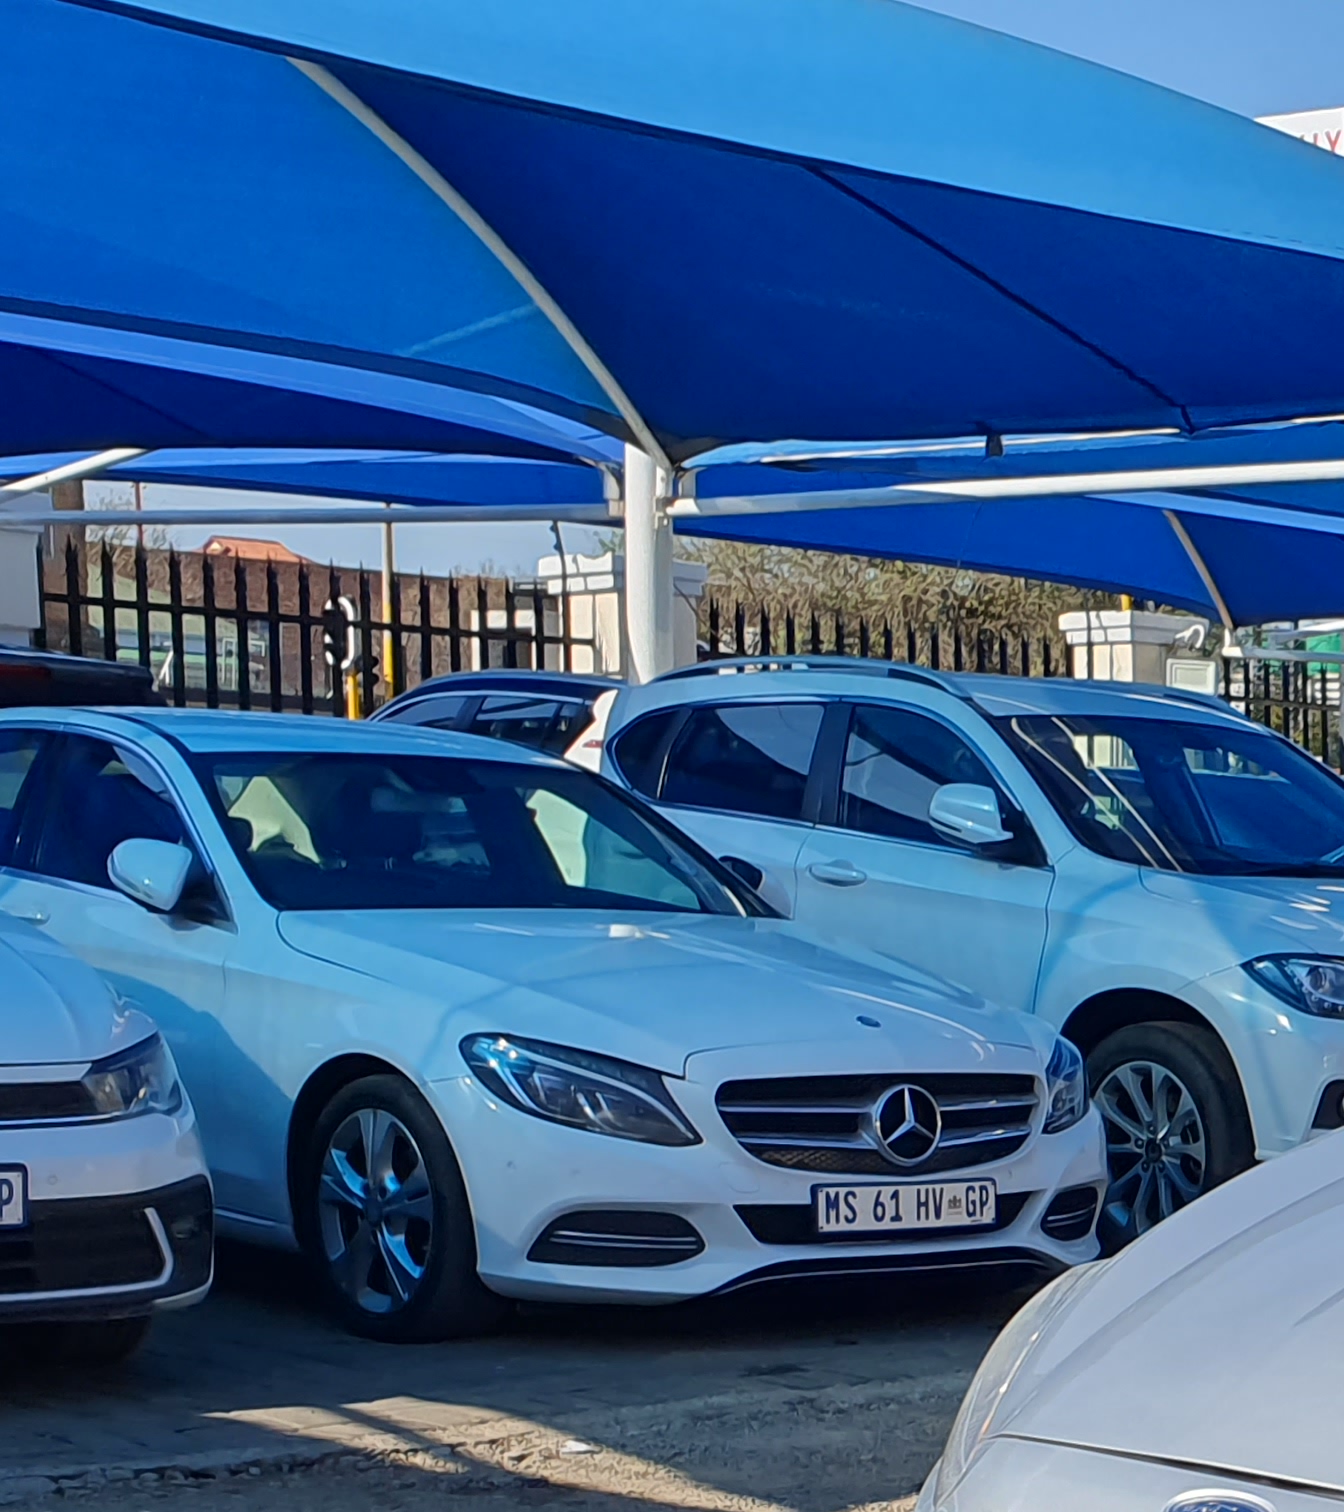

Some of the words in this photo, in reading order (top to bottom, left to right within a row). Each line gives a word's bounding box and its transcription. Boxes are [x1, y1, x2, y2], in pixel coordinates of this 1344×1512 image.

[825, 1190, 858, 1225] MS
[872, 1188, 903, 1223] 61
[916, 1187, 944, 1222] HV
[965, 1185, 989, 1219] GP
